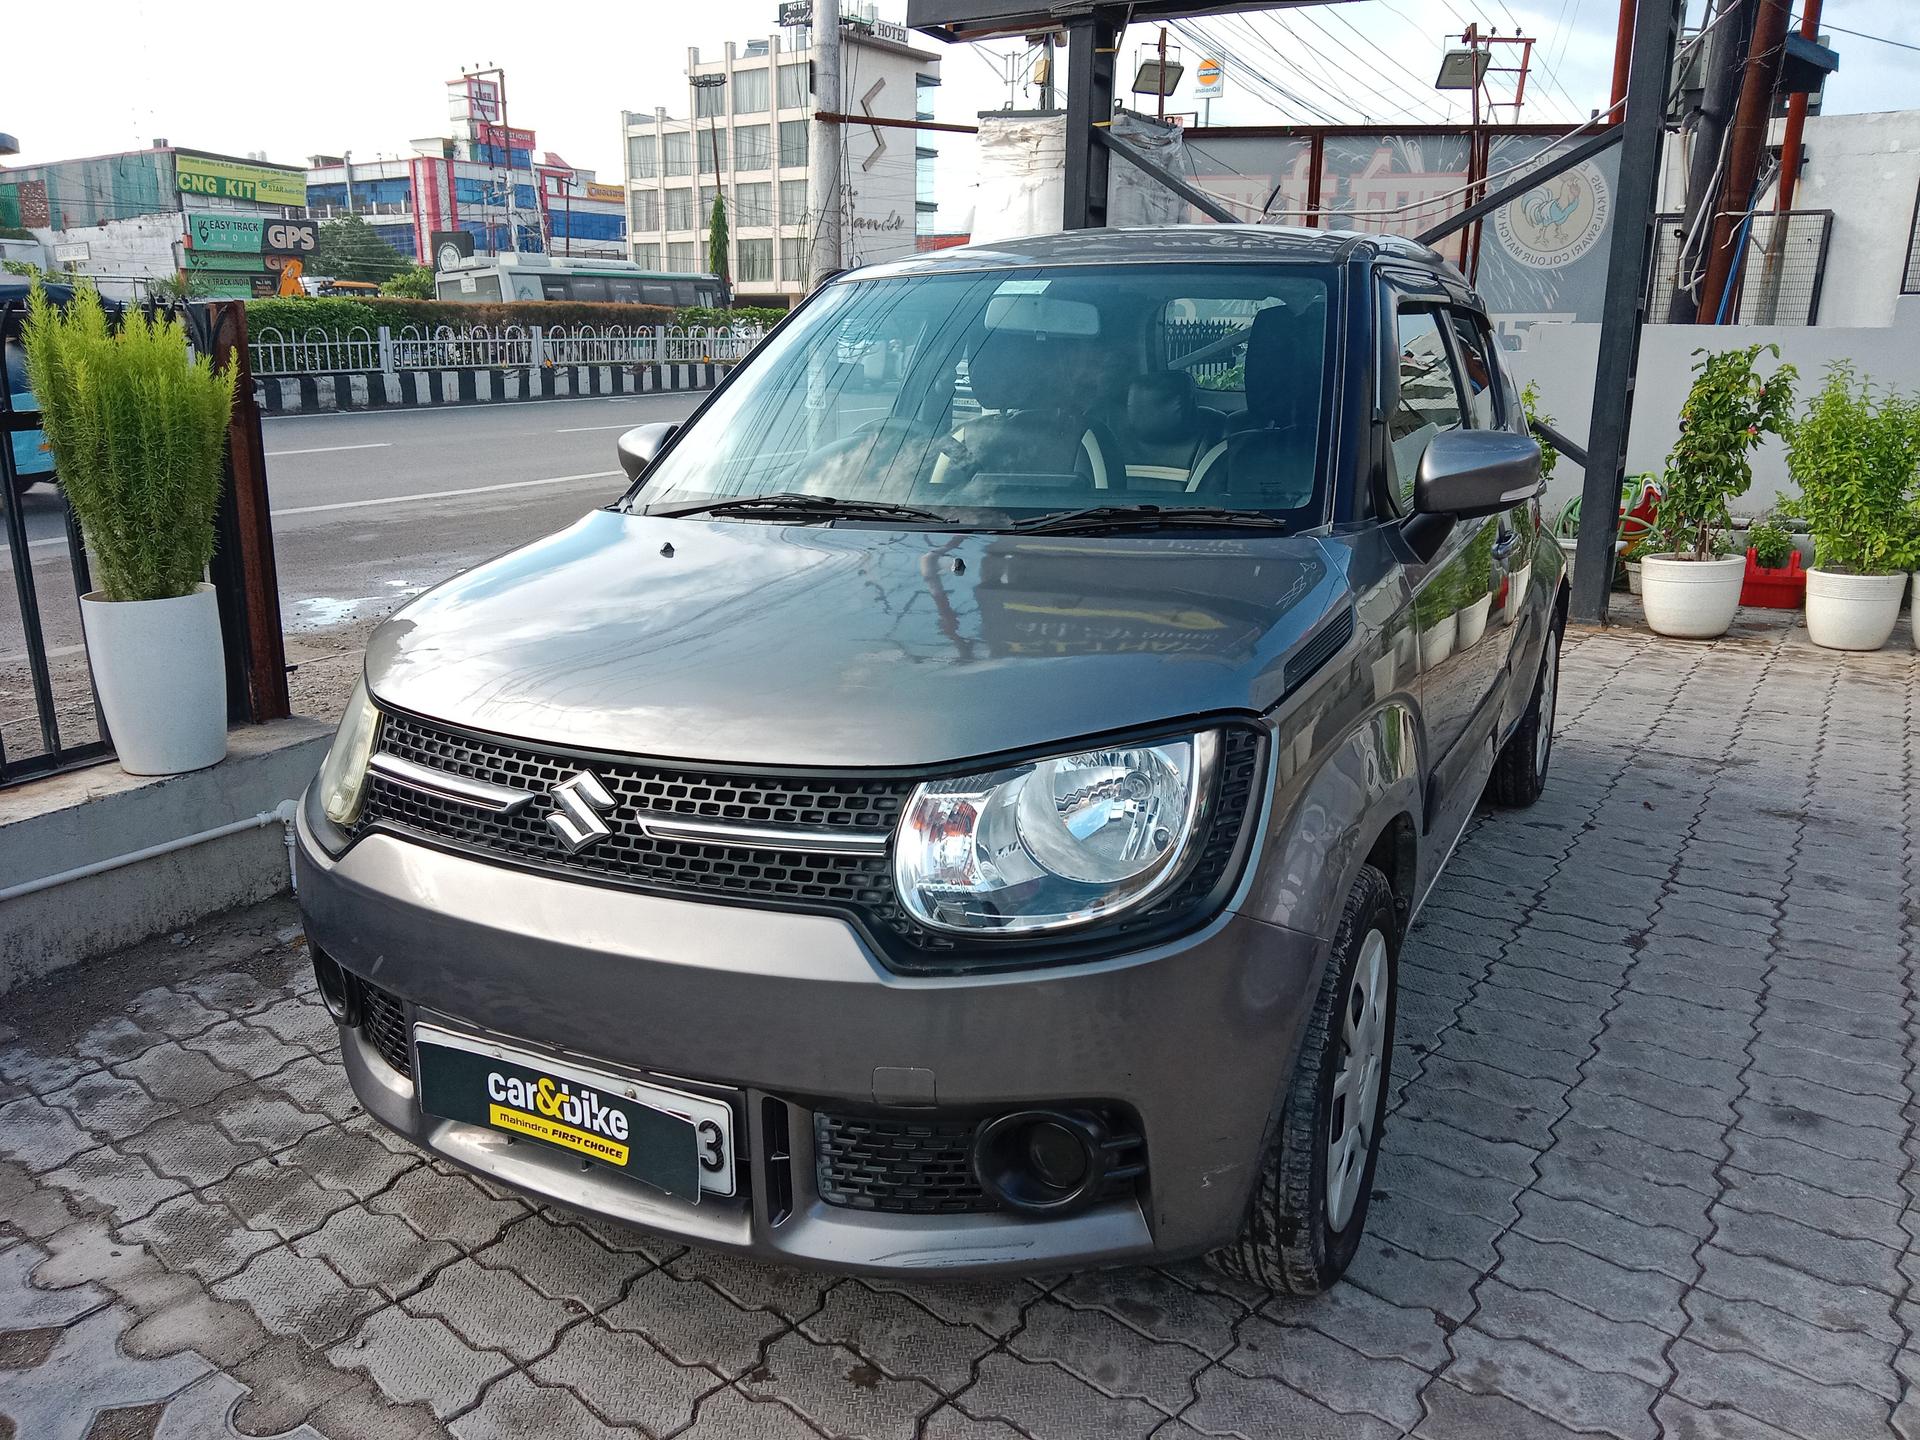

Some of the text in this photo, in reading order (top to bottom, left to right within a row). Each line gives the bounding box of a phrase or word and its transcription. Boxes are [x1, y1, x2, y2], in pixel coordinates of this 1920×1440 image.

[787, 1, 811, 11] HOTEL
[878, 22, 908, 43] HOTEL
[178, 173, 255, 199] CNG KIT
[209, 220, 259, 232] EASY TRACK
[211, 233, 260, 243] INDIA
[267, 224, 315, 251] GPS
[487, 1071, 630, 1141] car&bike
[499, 1112, 623, 1160] Mahindra FIRST CHOICE
[698, 1119, 724, 1173] 3
